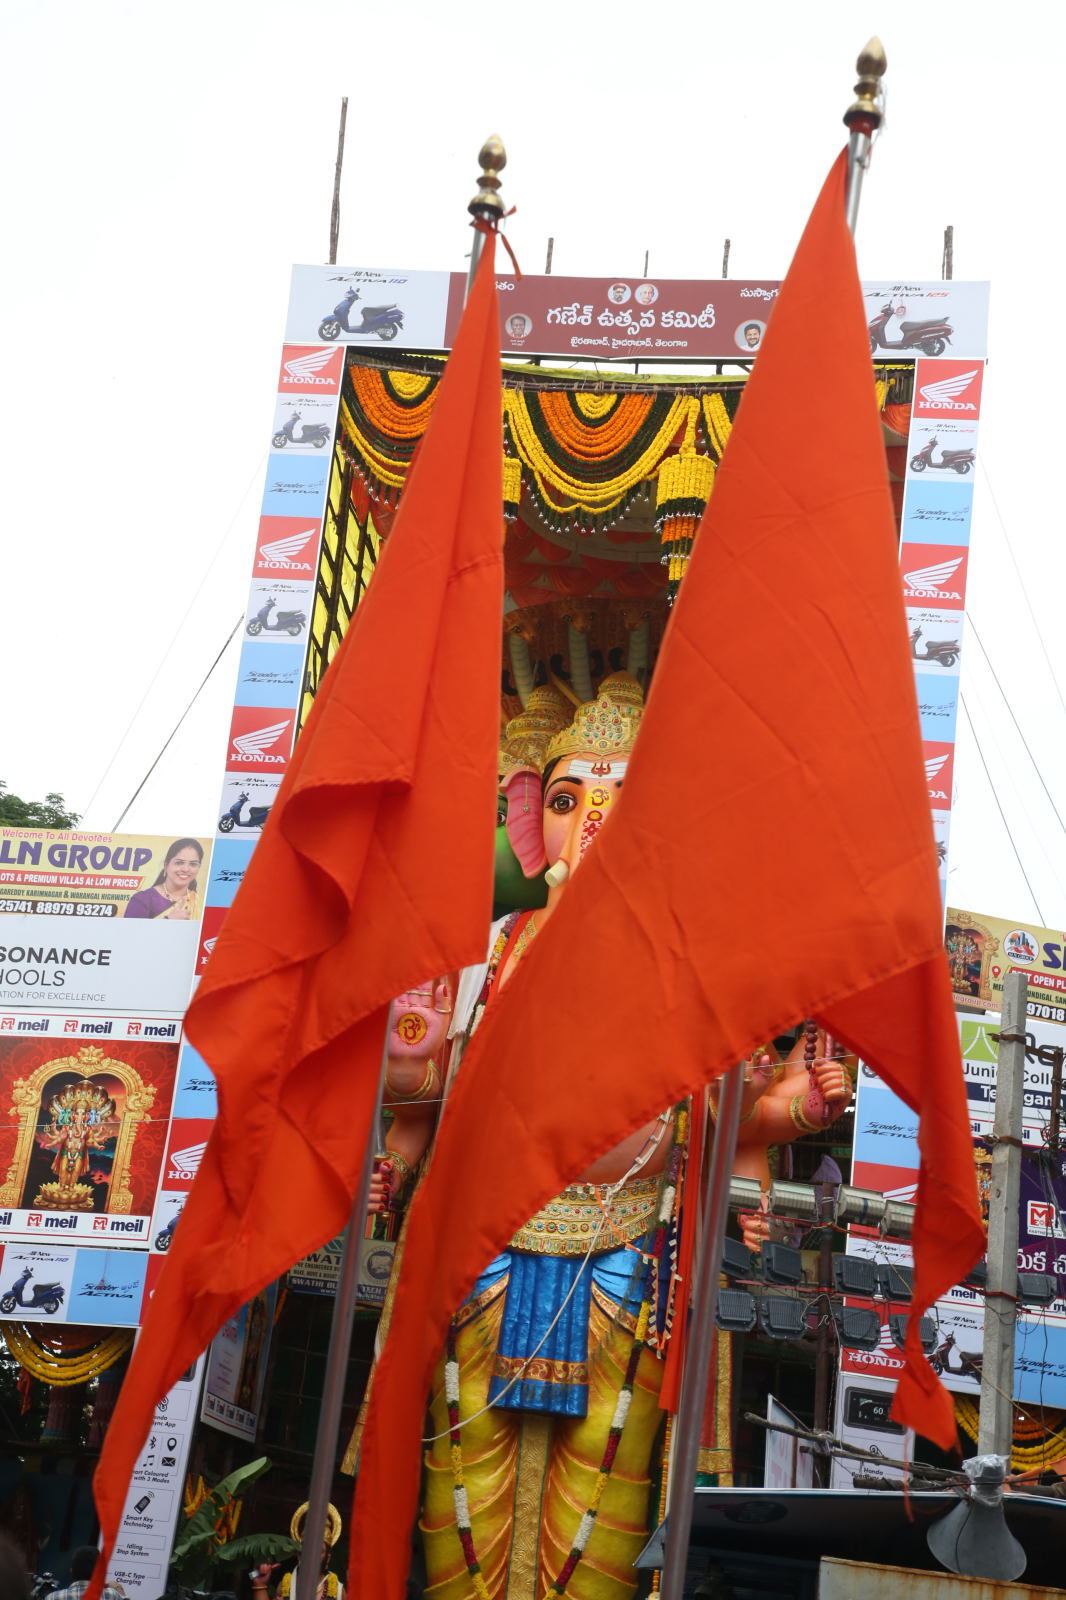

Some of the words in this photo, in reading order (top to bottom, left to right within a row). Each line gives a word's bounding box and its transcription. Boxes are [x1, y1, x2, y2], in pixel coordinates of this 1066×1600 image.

[597, 308, 655, 335] ఉత్సవ
[660, 303, 716, 328] కమిటీ
[283, 376, 336, 385] HONDA
[918, 401, 977, 410] HONDA
[257, 561, 312, 570] HONDA
[903, 589, 962, 600] HONDA
[230, 754, 286, 763] HONDA
[2, 829, 43, 839] Welcome
[57, 832, 69, 840] All
[72, 833, 112, 843] Devotees
[0, 840, 43, 865] LN
[47, 843, 153, 872] GROUP
[16, 874, 22, 882] &
[23, 874, 58, 884] PREMIUM
[59, 876, 84, 885] VILLAS
[95, 877, 110, 886] LOW
[112, 877, 139, 887] PRICES
[63, 890, 69, 898] &
[36, 901, 74, 915] 88979
[76, 904, 113, 916] 93274
[1034, 975, 1055, 987] OPEN
[26, 991, 45, 1000] FOR
[47, 992, 107, 1002] EXCELLENCE
[1027, 1002, 1065, 1021] 97018
[17, 1019, 50, 1032] meil
[80, 1021, 113, 1034] meil
[144, 1024, 176, 1037] meil
[963, 1063, 998, 1078] Juni
[45, 1216, 78, 1229] meil
[110, 1219, 144, 1233] meil
[951, 1289, 976, 1299] meil
[873, 1407, 883, 1415] 60
[123, 1521, 154, 1529] Technology
[116, 1578, 142, 1586] Charging
